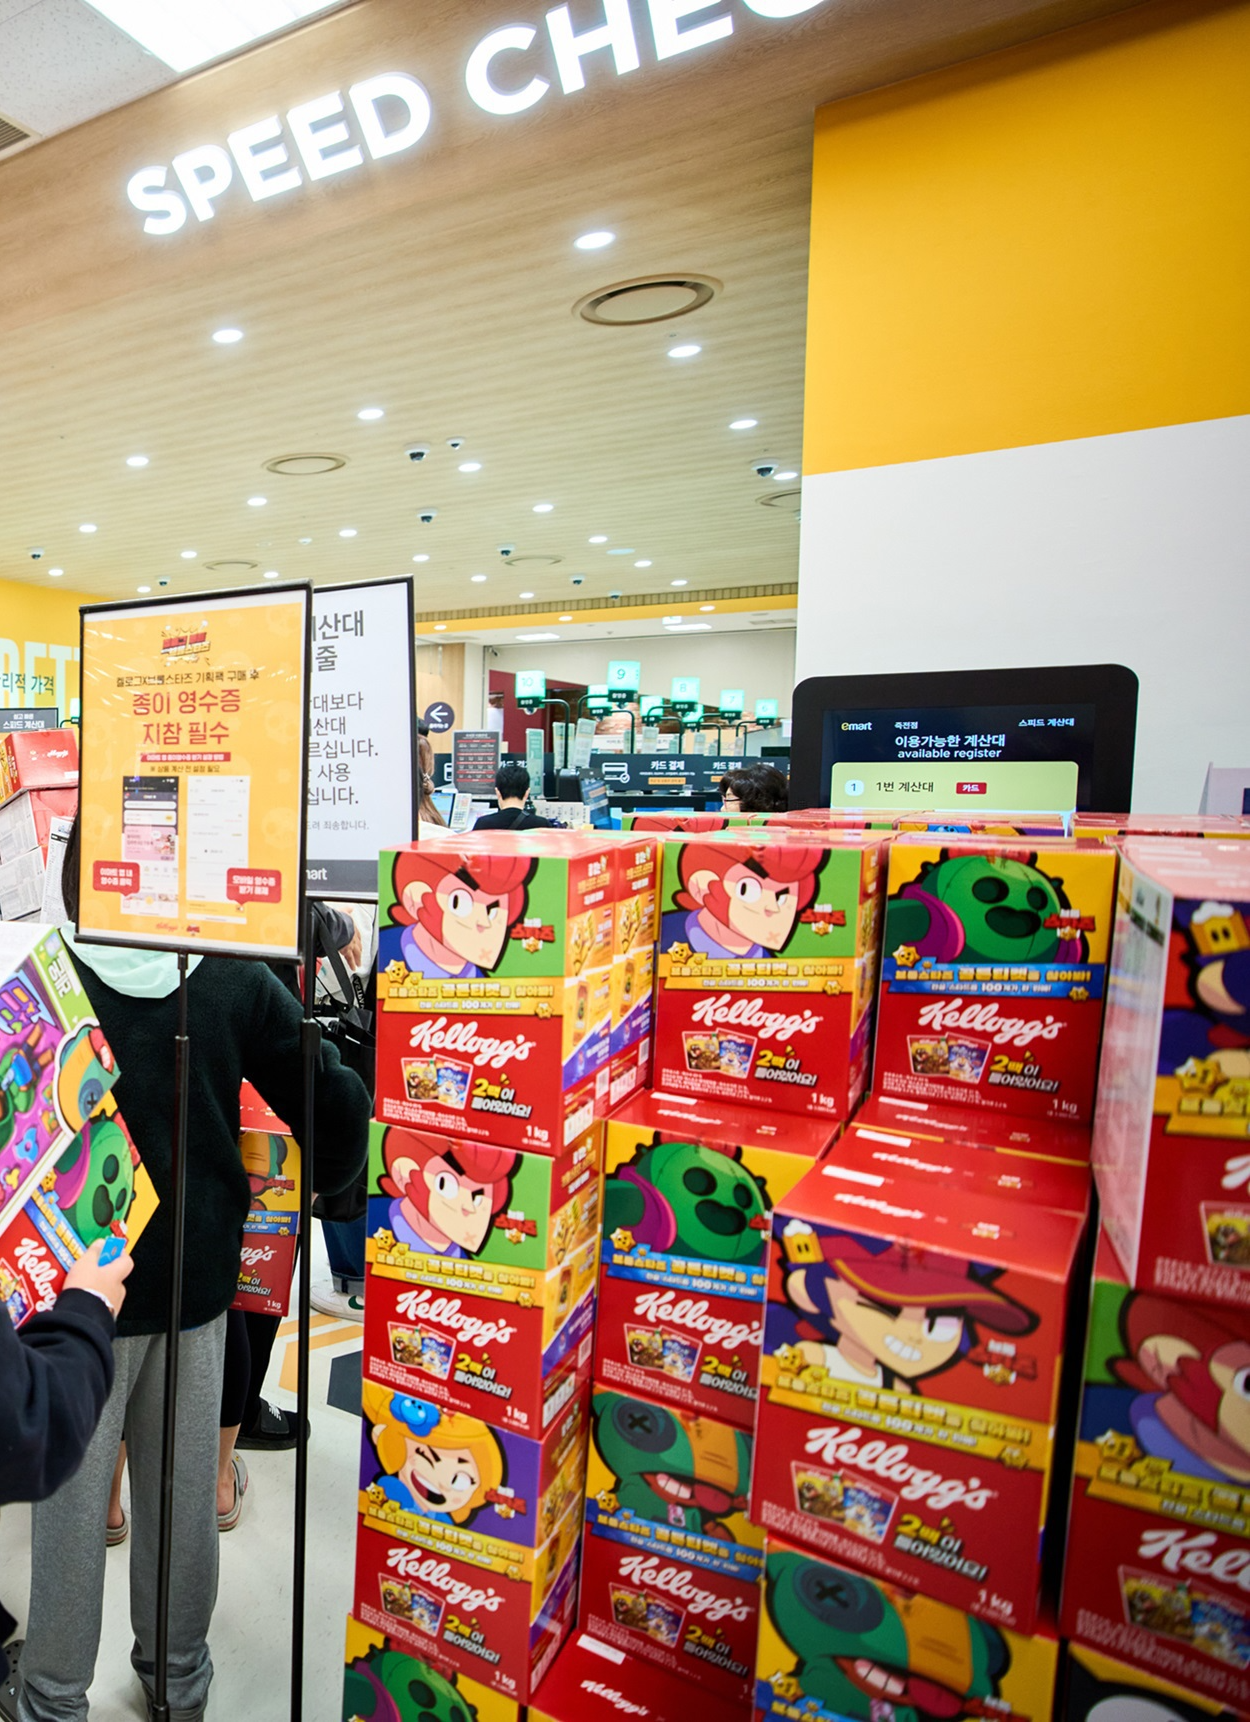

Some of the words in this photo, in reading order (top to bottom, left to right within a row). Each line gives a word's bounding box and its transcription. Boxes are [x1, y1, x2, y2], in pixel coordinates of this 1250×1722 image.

[126, 70, 433, 236] SPEED
[464, 0, 828, 116] CHE
[196, 672, 224, 683] 기획팩
[227, 670, 246, 681] 구매
[617, 669, 625, 679] 9
[31, 675, 54, 695] 가격
[680, 684, 686, 692] 8
[133, 692, 170, 716] 종이
[178, 689, 240, 714] 영수증
[310, 691, 363, 712] 대보다
[3, 721, 22, 729] 스피드
[24, 720, 44, 729] 계산대
[842, 722, 872, 731] emart
[895, 721, 918, 730] 죽전점
[1019, 719, 1045, 727] 스피드
[1047, 718, 1074, 727] 계산대
[143, 723, 182, 745] 지참
[189, 722, 229, 744] 필수
[895, 734, 960, 747] 이용가능한
[964, 734, 1005, 747] 계산대
[898, 749, 950, 758] available
[954, 749, 1001, 760] register
[317, 763, 350, 782] 사용
[651, 761, 667, 770] 카드
[669, 760, 685, 770] 결제
[713, 762, 726, 770] 카드
[851, 783, 856, 791] 1
[876, 782, 894, 792] 1번
[899, 781, 934, 792] 계산대
[962, 784, 979, 792] 카드
[323, 820, 369, 830] 죄송합니다.
[101, 877, 118, 885] 영수증
[255, 877, 275, 886] 영수증
[692, 993, 818, 1041] Kellogg's
[919, 998, 1063, 1047] Kellogg's
[410, 1016, 533, 1068] Kellogg's
[755, 1050, 800, 1070] 2팩이
[990, 1055, 1039, 1076] 2팩이
[754, 1067, 817, 1087] 들어있어요!
[988, 1072, 1059, 1093] 들어있어요!
[472, 1078, 515, 1100] 2팩이
[471, 1096, 532, 1118] 들어있어요!
[811, 1093, 817, 1104] 1
[819, 1094, 834, 1107] kg
[1052, 1099, 1058, 1108] 1
[1062, 1100, 1077, 1113] kg
[526, 1125, 531, 1137] 1
[534, 1127, 549, 1141] kg
[267, 1299, 271, 1307] 1
[272, 1300, 282, 1309] kg
[396, 1289, 514, 1347] Kellogg's
[634, 1290, 763, 1349] Kellogg's
[454, 1353, 496, 1379] 2팩이
[701, 1356, 747, 1380] 2팩이
[453, 1372, 513, 1399] 들어있어요!
[506, 1405, 511, 1416] 1
[514, 1408, 528, 1423] kg
[805, 1427, 992, 1510] Kellogg's
[894, 1535, 988, 1582] 들어있어요!
[387, 1548, 503, 1611] Kellogg's
[619, 1555, 751, 1621] Kellogg's
[978, 1589, 986, 1604] 1
[443, 1630, 500, 1666] 들어있어요!
[683, 1642, 749, 1678] 들어있어요!
[494, 1671, 499, 1680] 1
[502, 1676, 516, 1690] kg
[581, 1679, 649, 1716] Kellogg's
